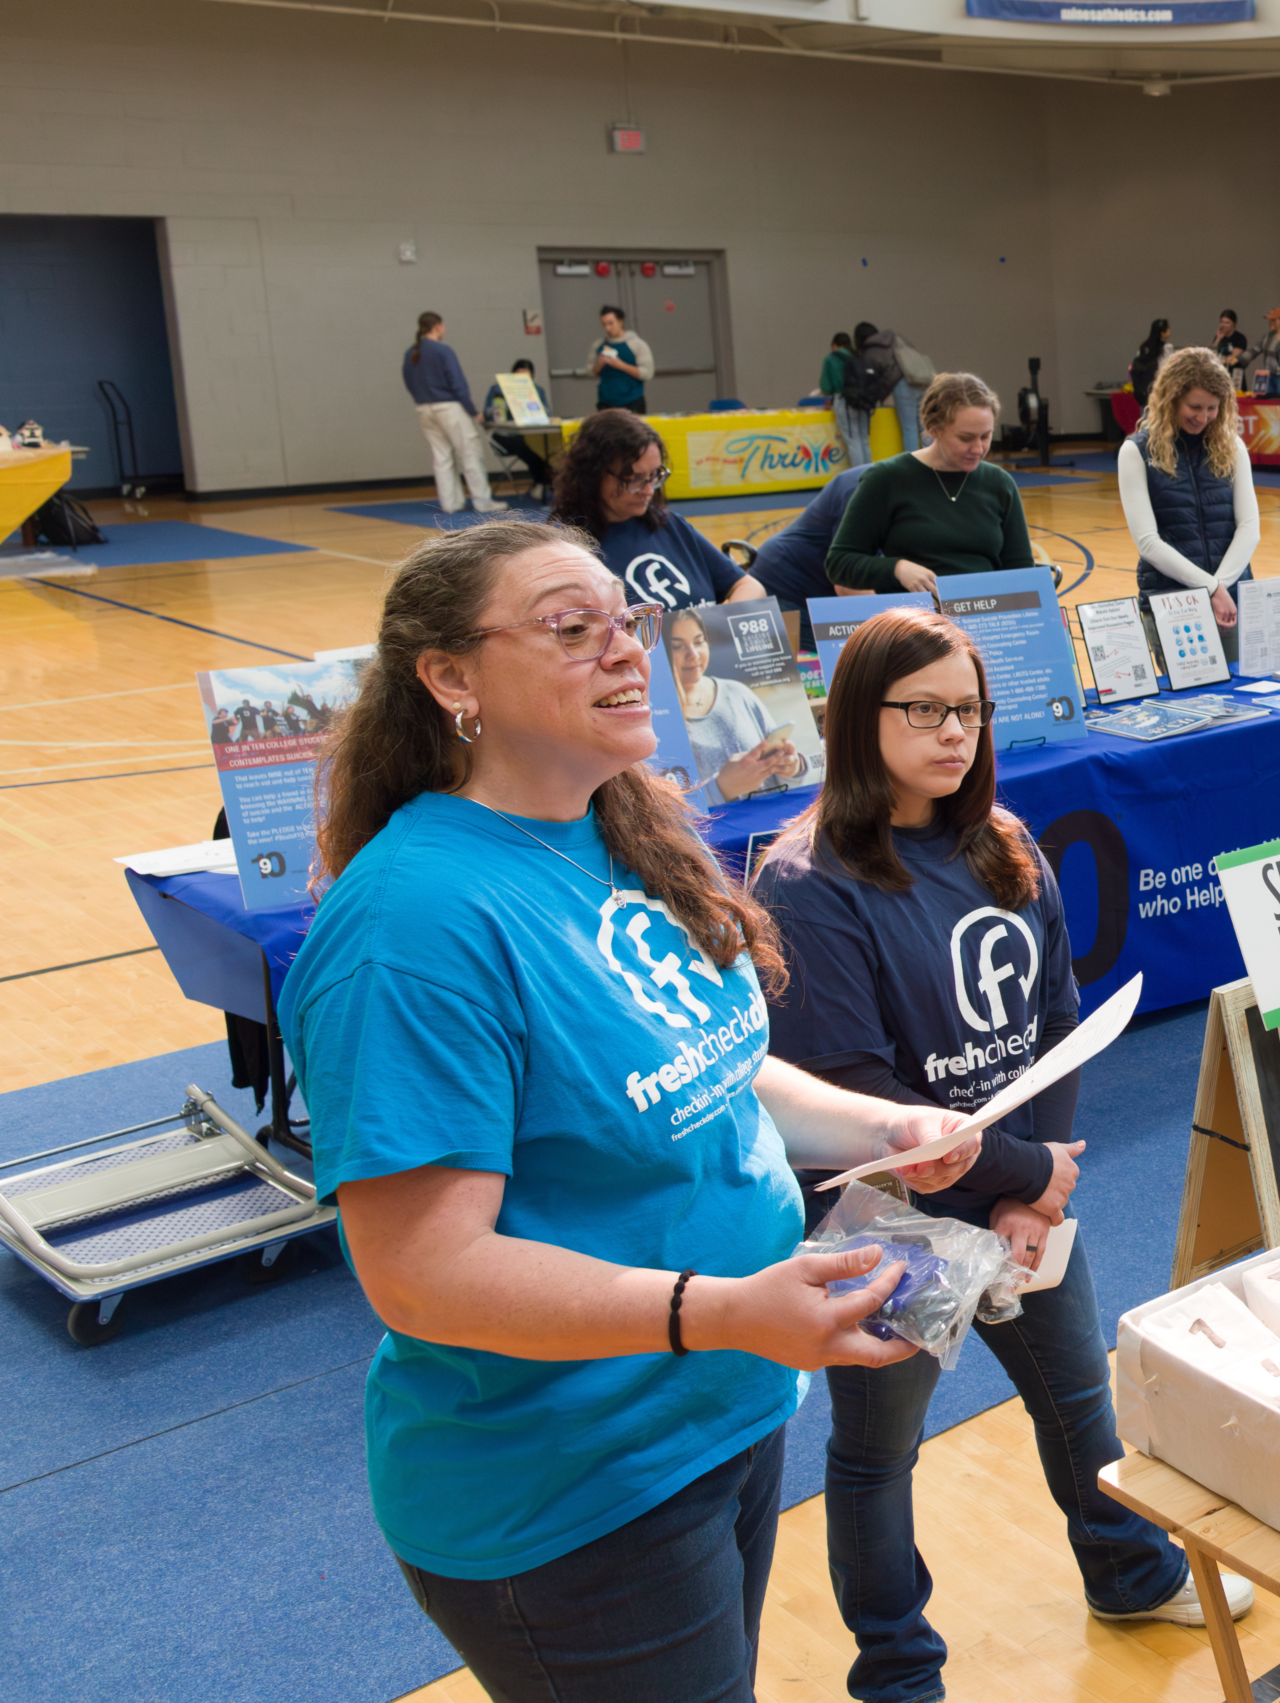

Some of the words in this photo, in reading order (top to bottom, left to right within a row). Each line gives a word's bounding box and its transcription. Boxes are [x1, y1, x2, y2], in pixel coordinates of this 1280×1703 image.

[954, 602, 971, 613] GET
[974, 598, 997, 610] HELP
[738, 618, 769, 635] 988
[225, 744, 240, 754] ONE
[242, 743, 250, 751] IN
[251, 741, 265, 751] TEN
[266, 738, 297, 750] COLLEGE
[229, 753, 285, 768] CONTEMPLATES
[1139, 868, 1166, 892] Be
[1171, 862, 1203, 886] one
[1138, 894, 1182, 919] who
[991, 1070, 1006, 1088] with
